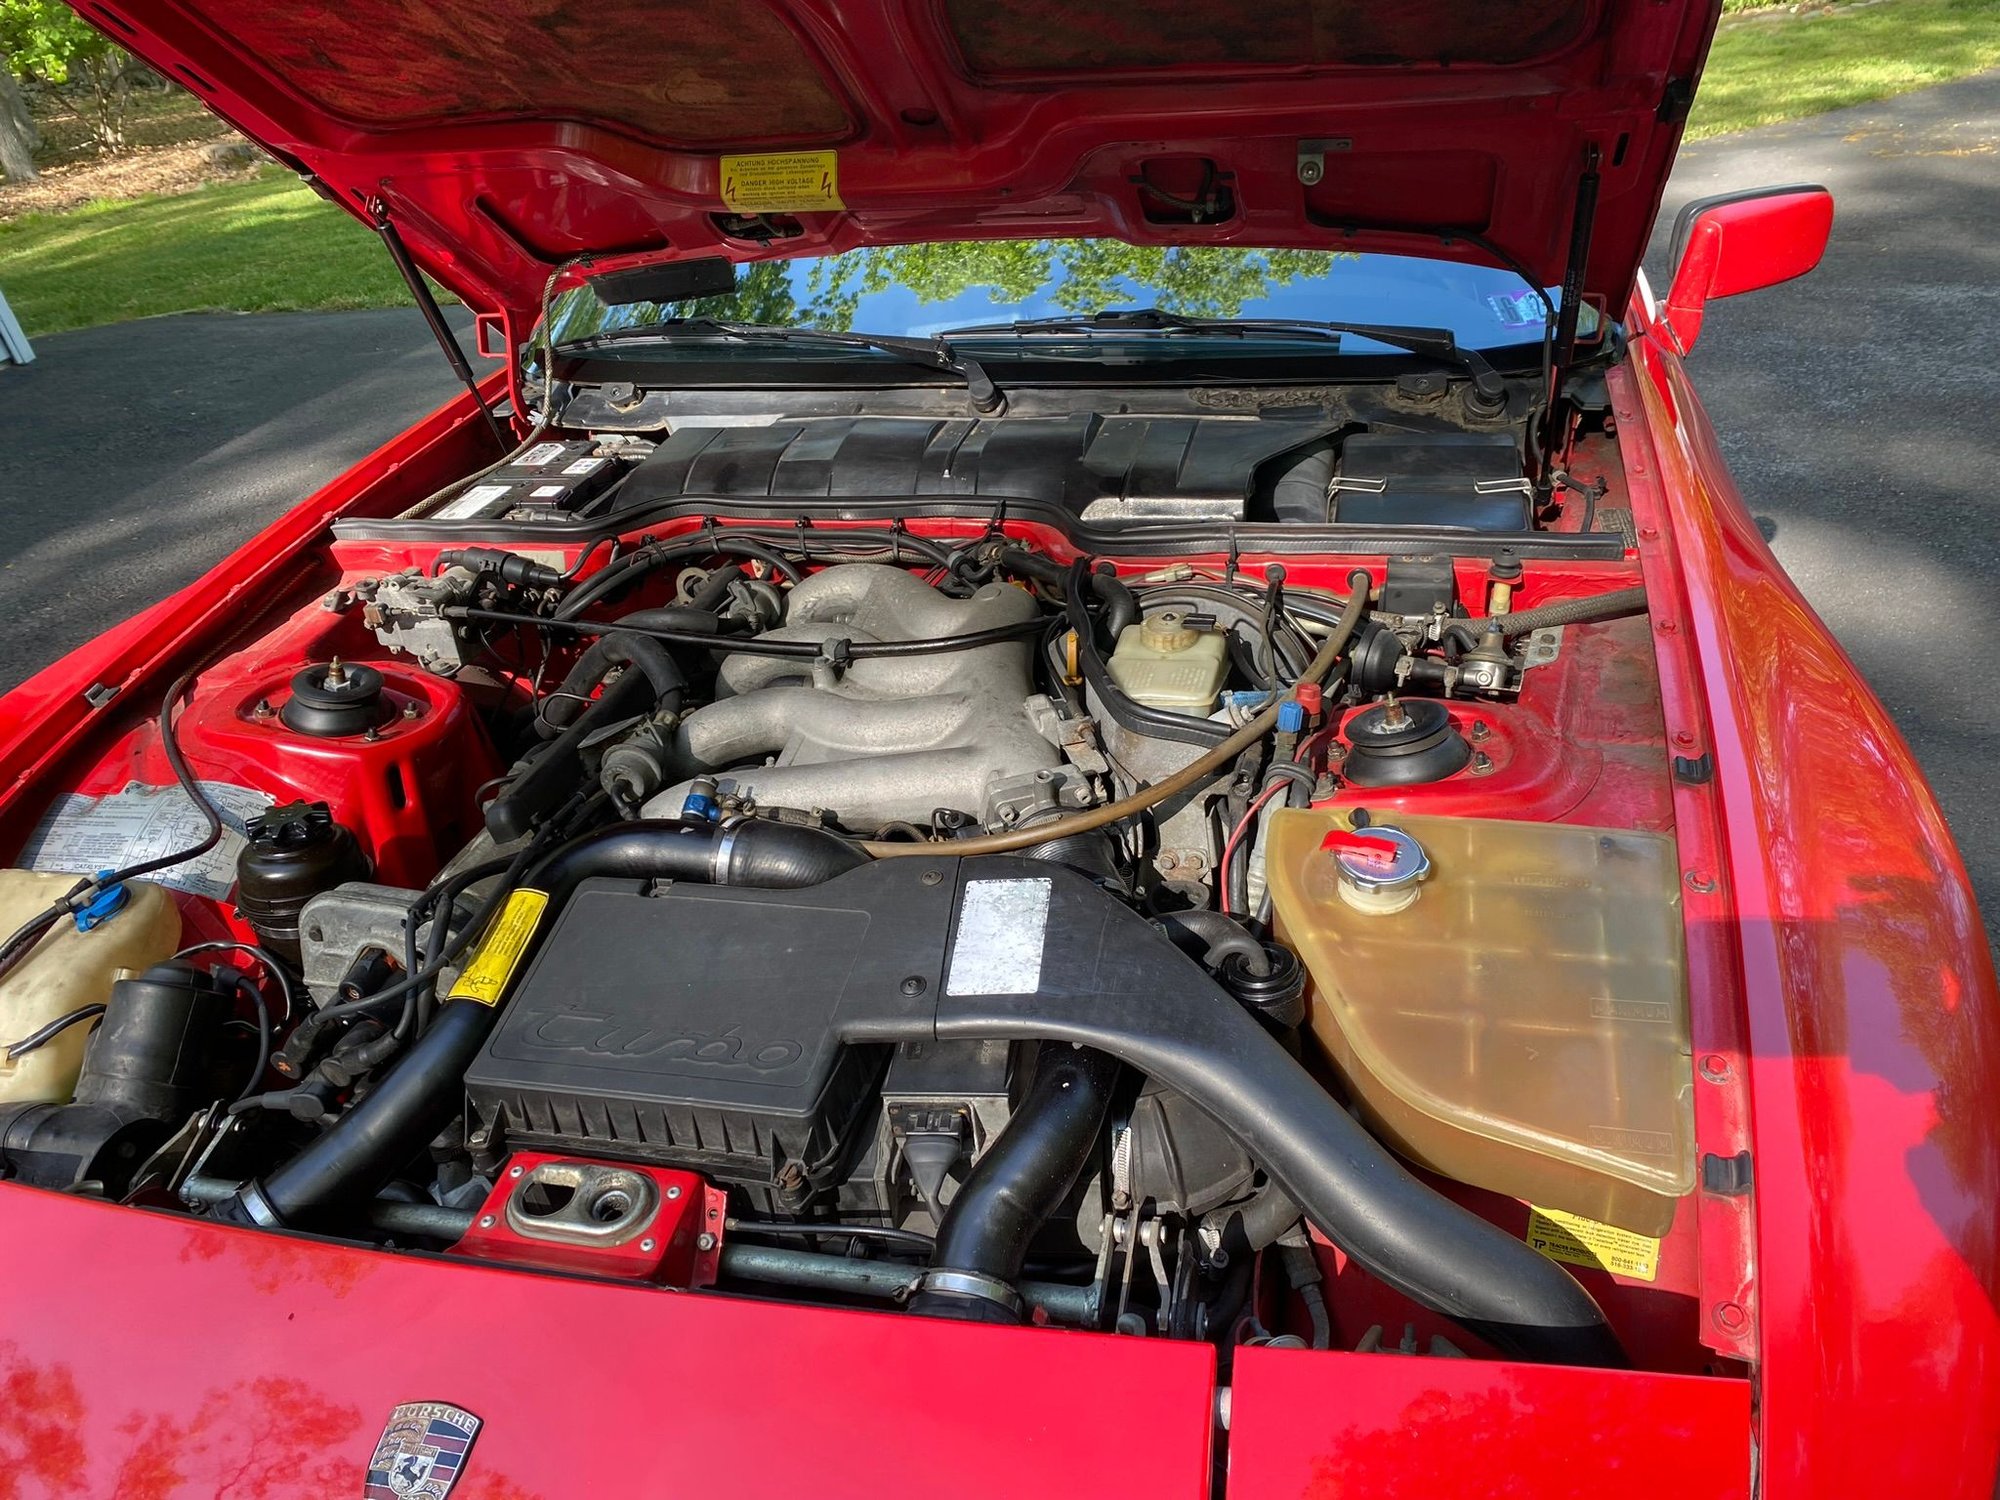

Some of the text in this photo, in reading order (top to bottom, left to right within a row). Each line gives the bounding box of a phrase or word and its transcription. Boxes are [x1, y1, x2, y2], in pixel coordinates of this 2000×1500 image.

[736, 160, 765, 168] ACHTUNG
[767, 157, 820, 166] HOCHSPANNUNG
[787, 177, 815, 185] VOLTAGE
[392, 1405, 475, 1433] PORSCHE
[400, 1443, 438, 1457] STUTTGART
